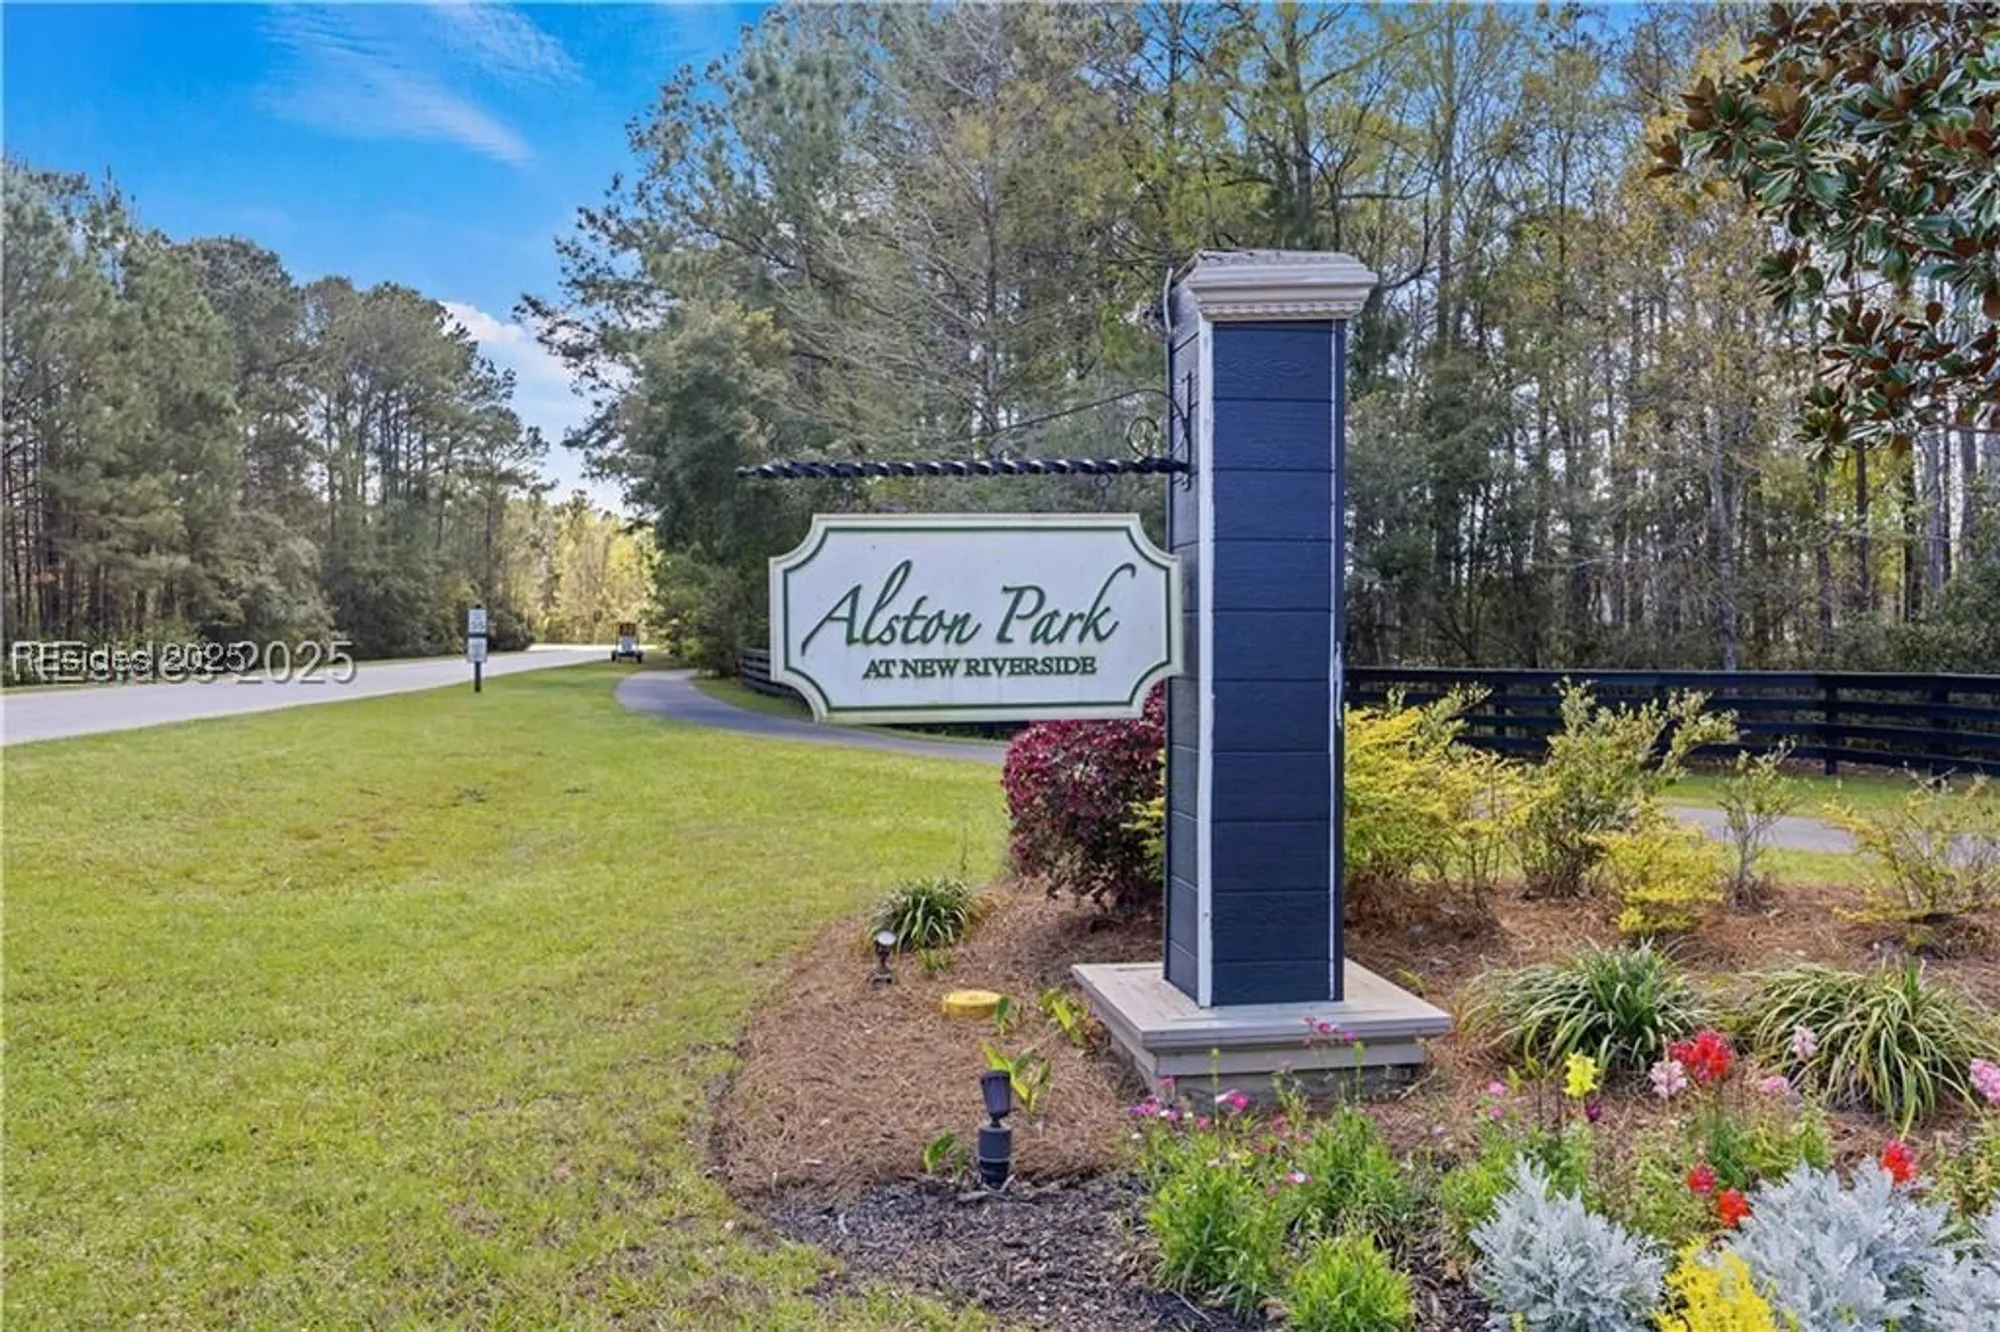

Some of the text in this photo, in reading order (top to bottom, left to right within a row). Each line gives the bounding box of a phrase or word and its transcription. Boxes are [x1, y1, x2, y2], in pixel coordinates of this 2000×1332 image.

[803, 559, 1136, 656] Alston Park
[862, 656, 1098, 680] AT NEW RIVERSIDE
